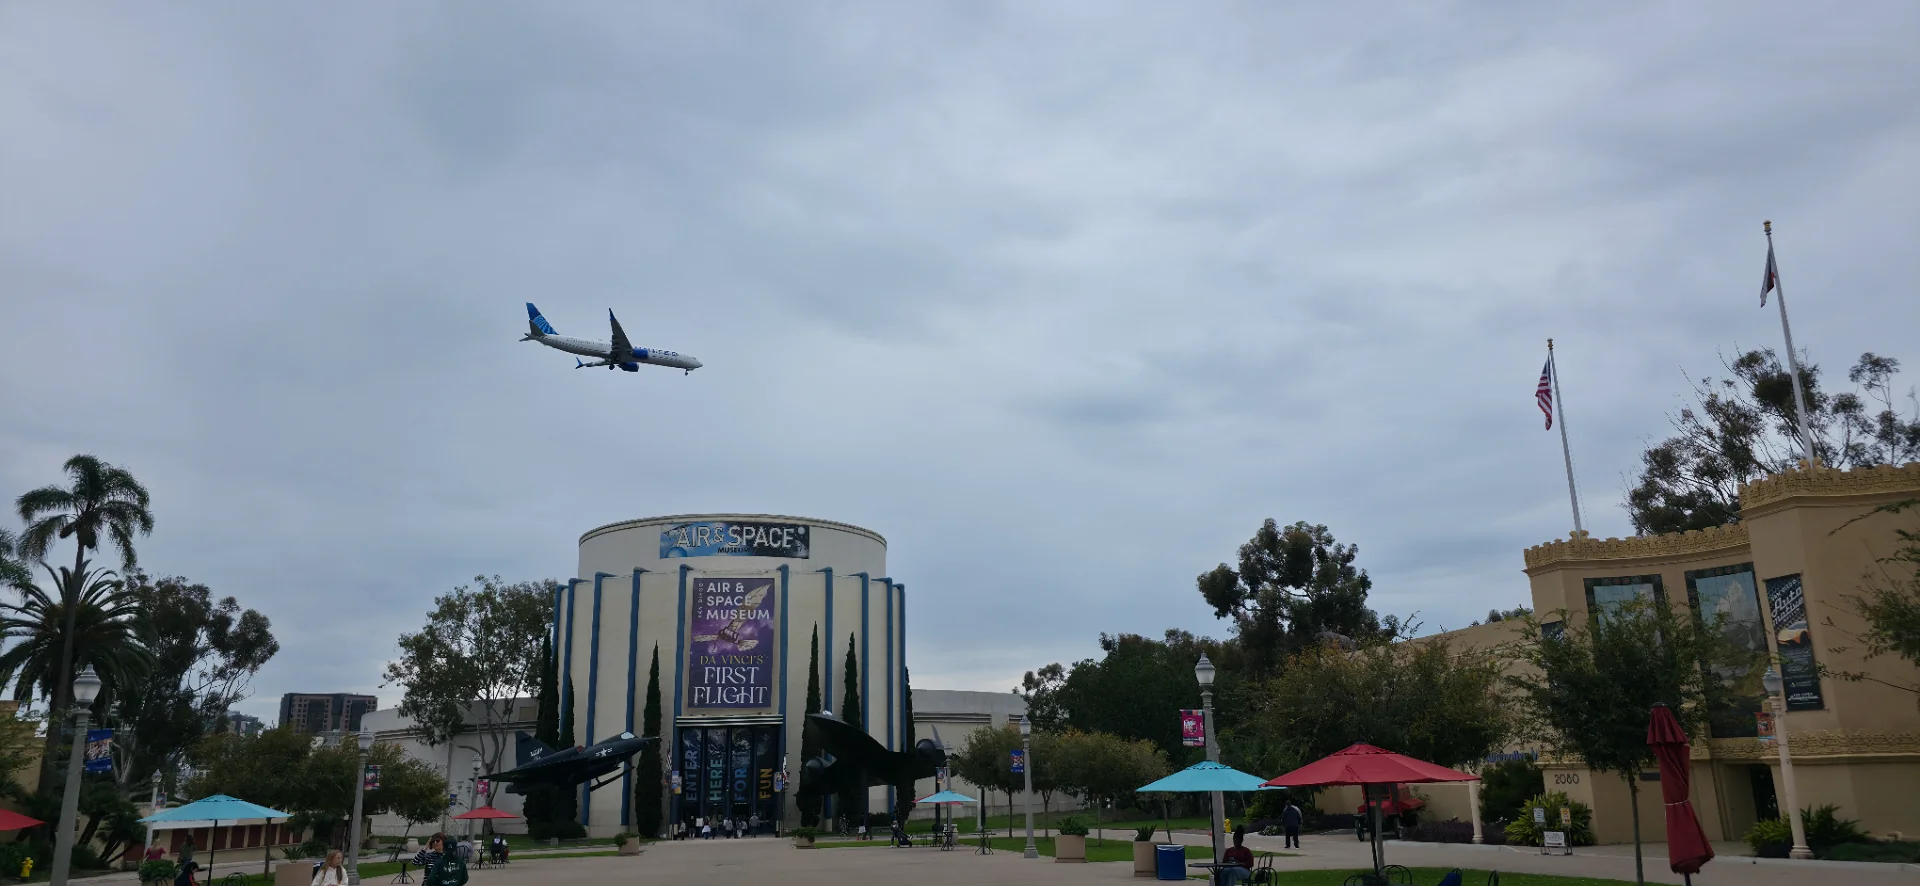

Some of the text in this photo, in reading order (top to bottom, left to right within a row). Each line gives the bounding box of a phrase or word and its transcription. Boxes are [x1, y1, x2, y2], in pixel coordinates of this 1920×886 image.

[677, 525, 711, 548] AIR
[728, 525, 795, 548] SPACE
[706, 582, 745, 593] AIR &
[706, 595, 752, 607] SPACE
[706, 609, 770, 620] MUSEUM
[700, 655, 764, 665] DA VINCI'S
[704, 666, 760, 684] FIRST
[693, 686, 768, 704] FLIGHT
[685, 750, 698, 801] ENTER
[709, 759, 723, 801] HERE
[734, 768, 747, 801] FOR
[760, 768, 773, 799] FUN
[1554, 773, 1580, 784] 2080
